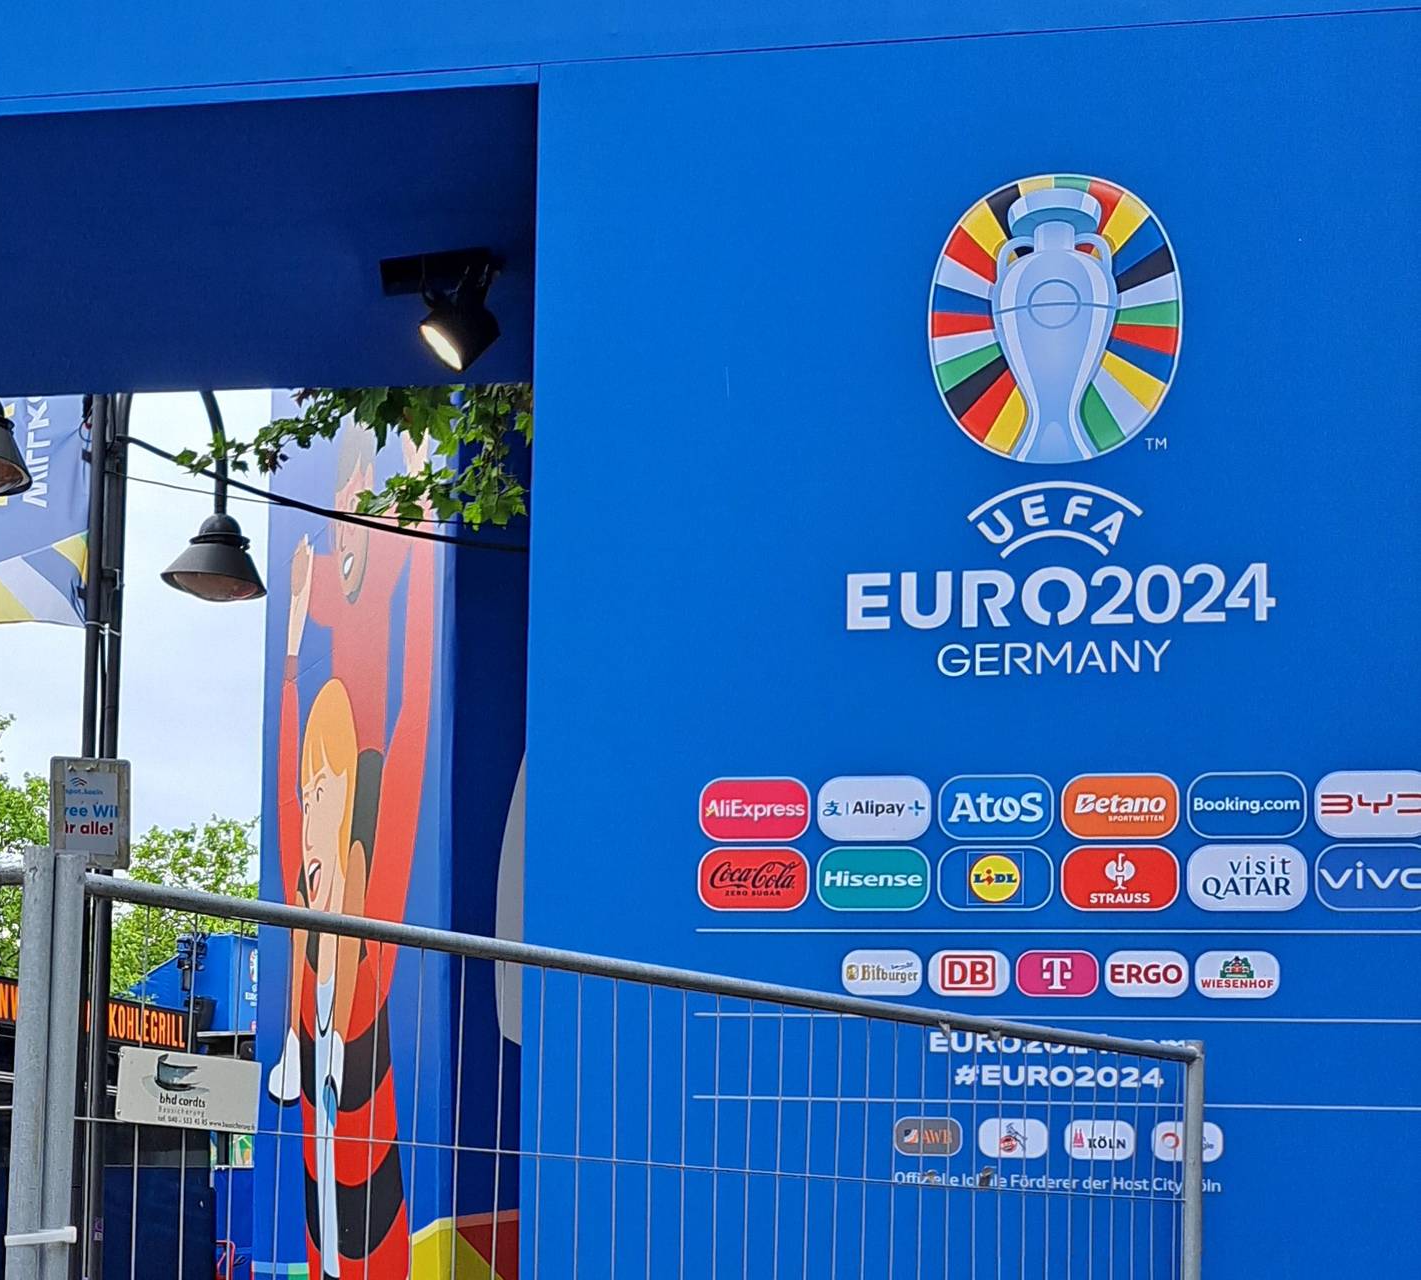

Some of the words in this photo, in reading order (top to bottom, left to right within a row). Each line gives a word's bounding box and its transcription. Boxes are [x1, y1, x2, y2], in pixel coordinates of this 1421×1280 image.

[1144, 437, 1168, 451] TM
[977, 494, 1125, 546] UEFA
[846, 563, 1277, 631] EURO2024
[937, 640, 1171, 677] GERMANY
[705, 798, 805, 821] AliExpress
[1074, 793, 1167, 814] Betano
[1193, 796, 1300, 814] Booking.com
[80, 821, 114, 836] alle!
[1108, 815, 1165, 823] SPORTWETTEN
[1229, 855, 1292, 875] visit
[824, 869, 923, 887] Hisense
[1201, 876, 1292, 900] QATAR
[1089, 893, 1151, 904] STRAUSS
[861, 964, 919, 984] Bitburger
[947, 960, 989, 986] DB
[1042, 957, 1072, 990] T
[1110, 963, 1183, 984] ERGO
[1200, 979, 1275, 989] WIESENHOF
[108, 1003, 186, 1049] KOHLEGRILL
[954, 1064, 1165, 1088] #EURO2024
[159, 1092, 178, 1105] bhd
[179, 1096, 206, 1108] cordts
[1087, 1136, 1126, 1150] KÖLN
[1010, 1173, 1080, 1190] Förderer
[1082, 1176, 1110, 1190] der
[1113, 1178, 1149, 1191] Host
[1152, 1178, 1183, 1195] City
